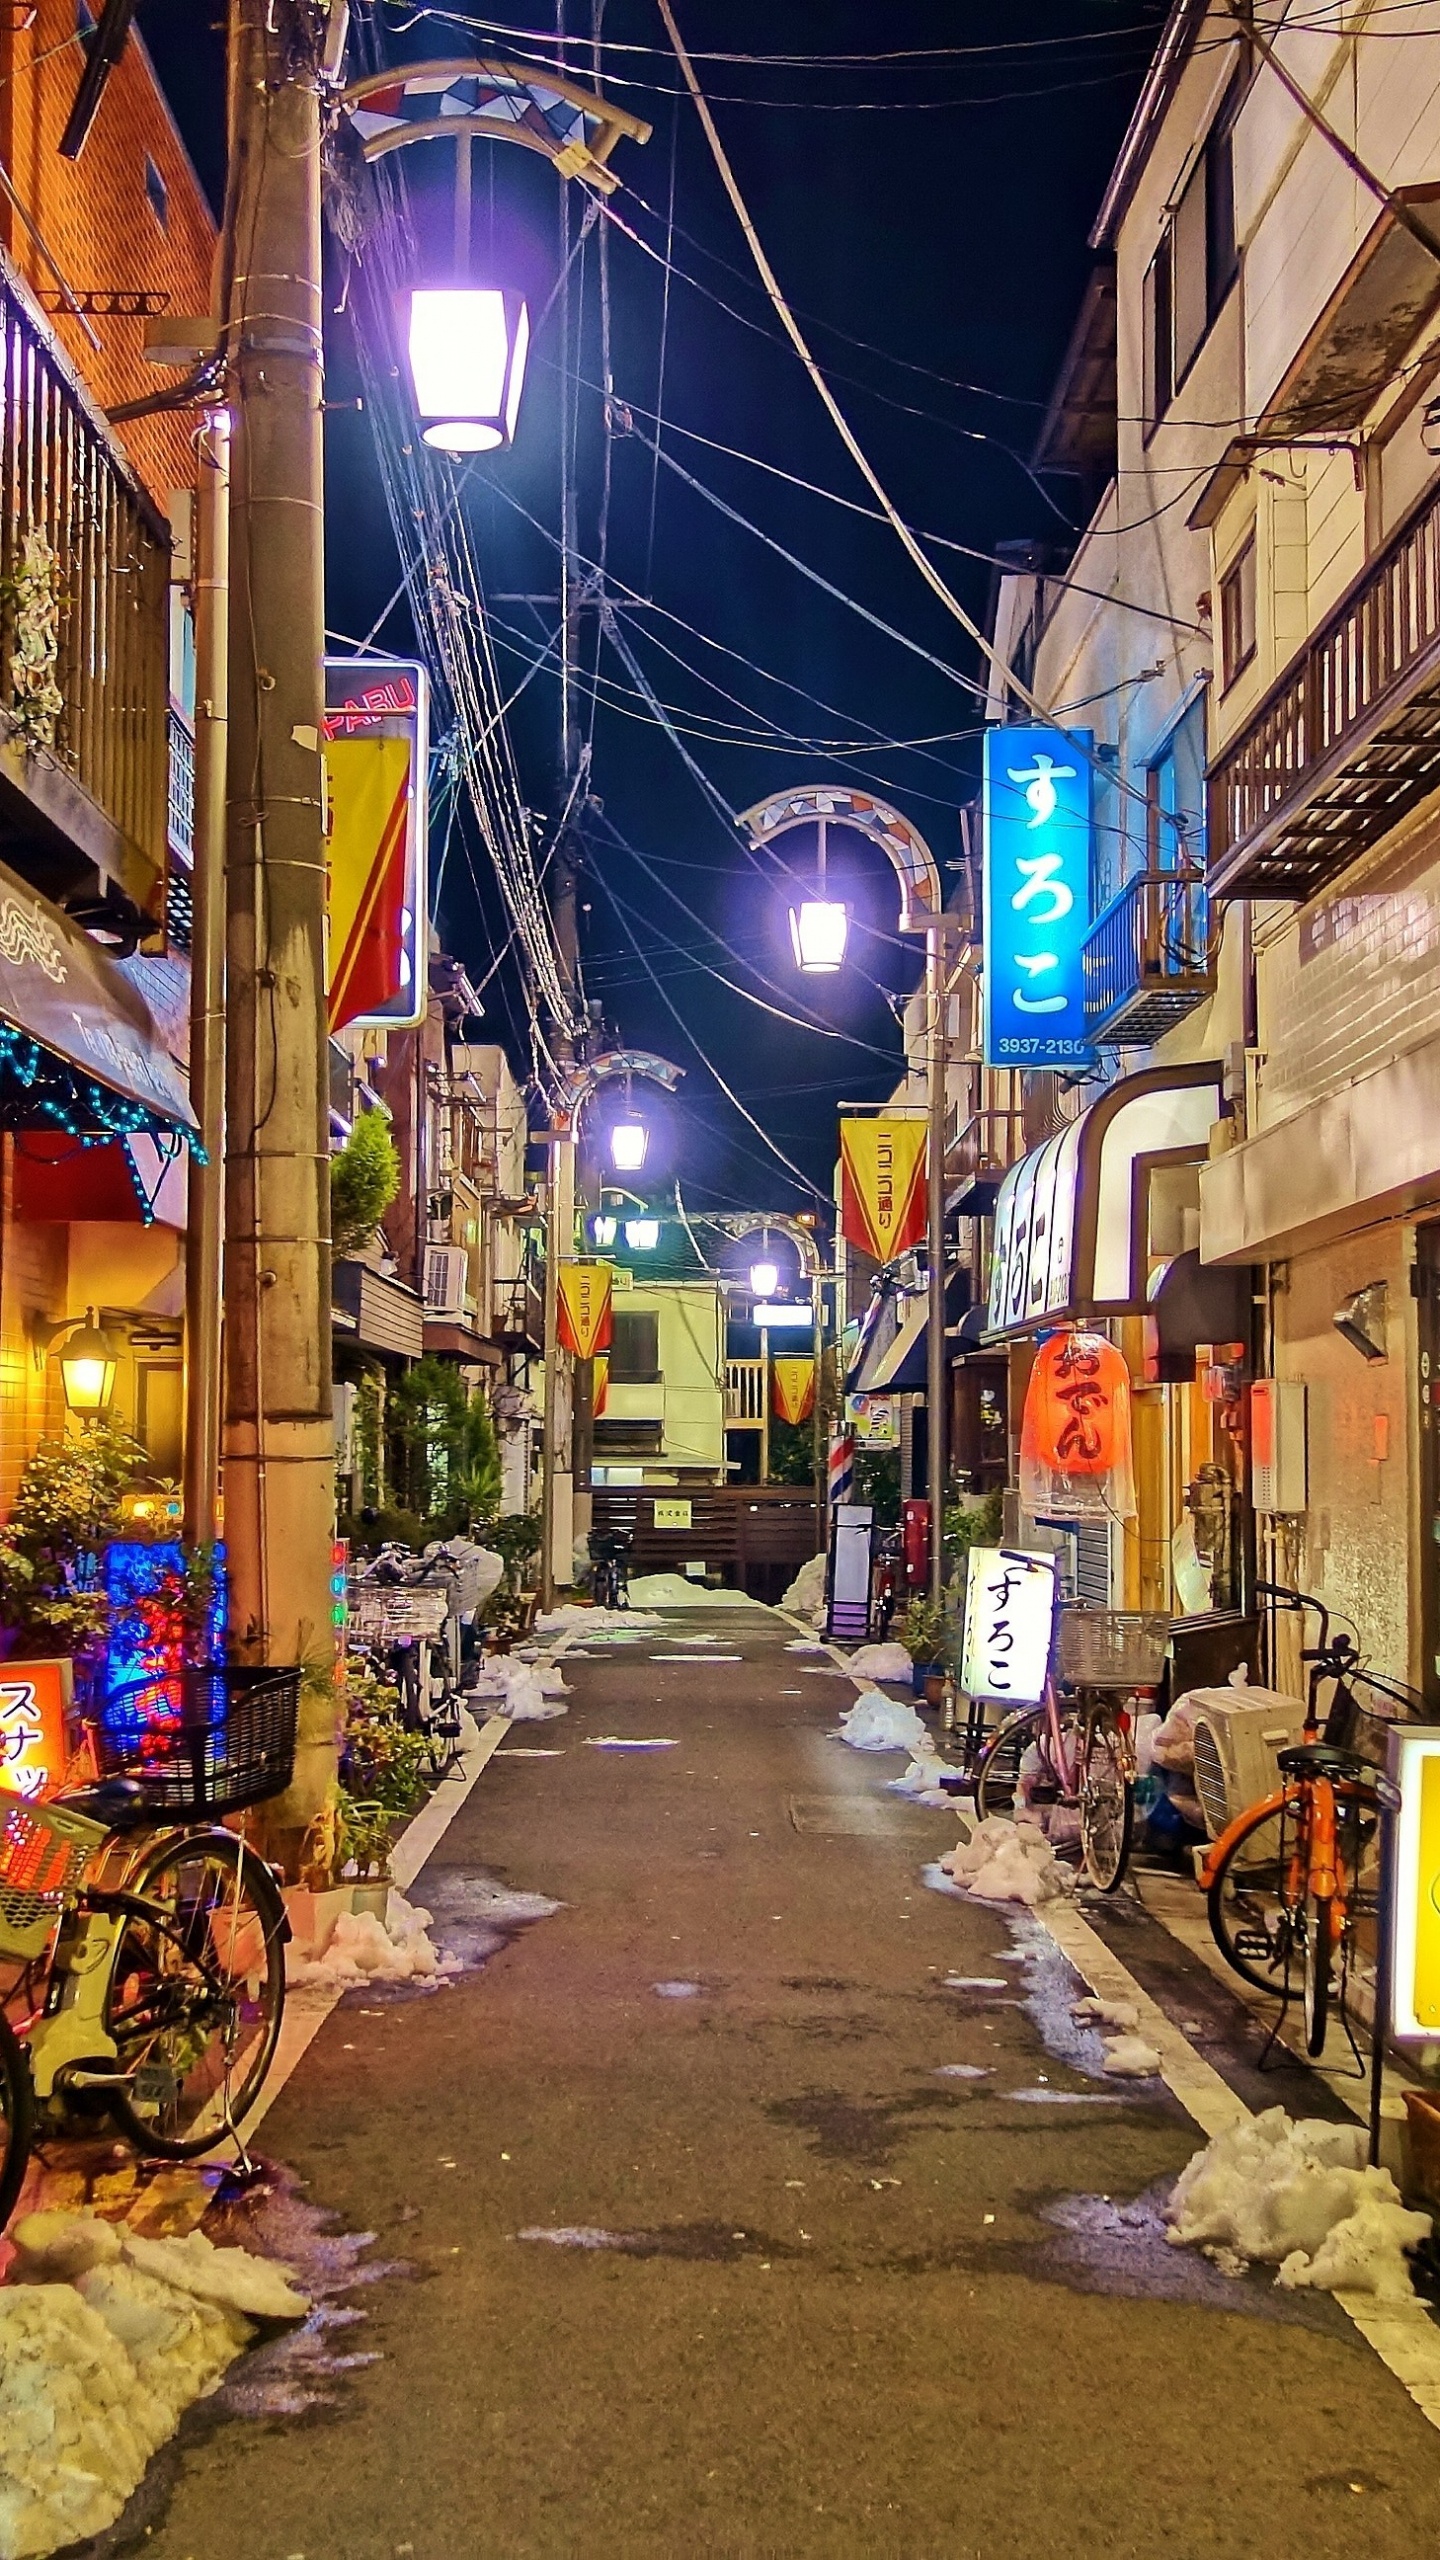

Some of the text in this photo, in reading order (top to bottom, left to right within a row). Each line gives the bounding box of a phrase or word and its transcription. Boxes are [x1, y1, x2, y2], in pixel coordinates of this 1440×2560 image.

[1007, 753, 1077, 1013] すろこ
[998, 1037, 1086, 1055] 3937-2130
[877, 1133, 893, 1229] ニコニコ通り
[1053, 1344, 1108, 1460] おでん
[987, 1571, 1022, 1690] すろこ
